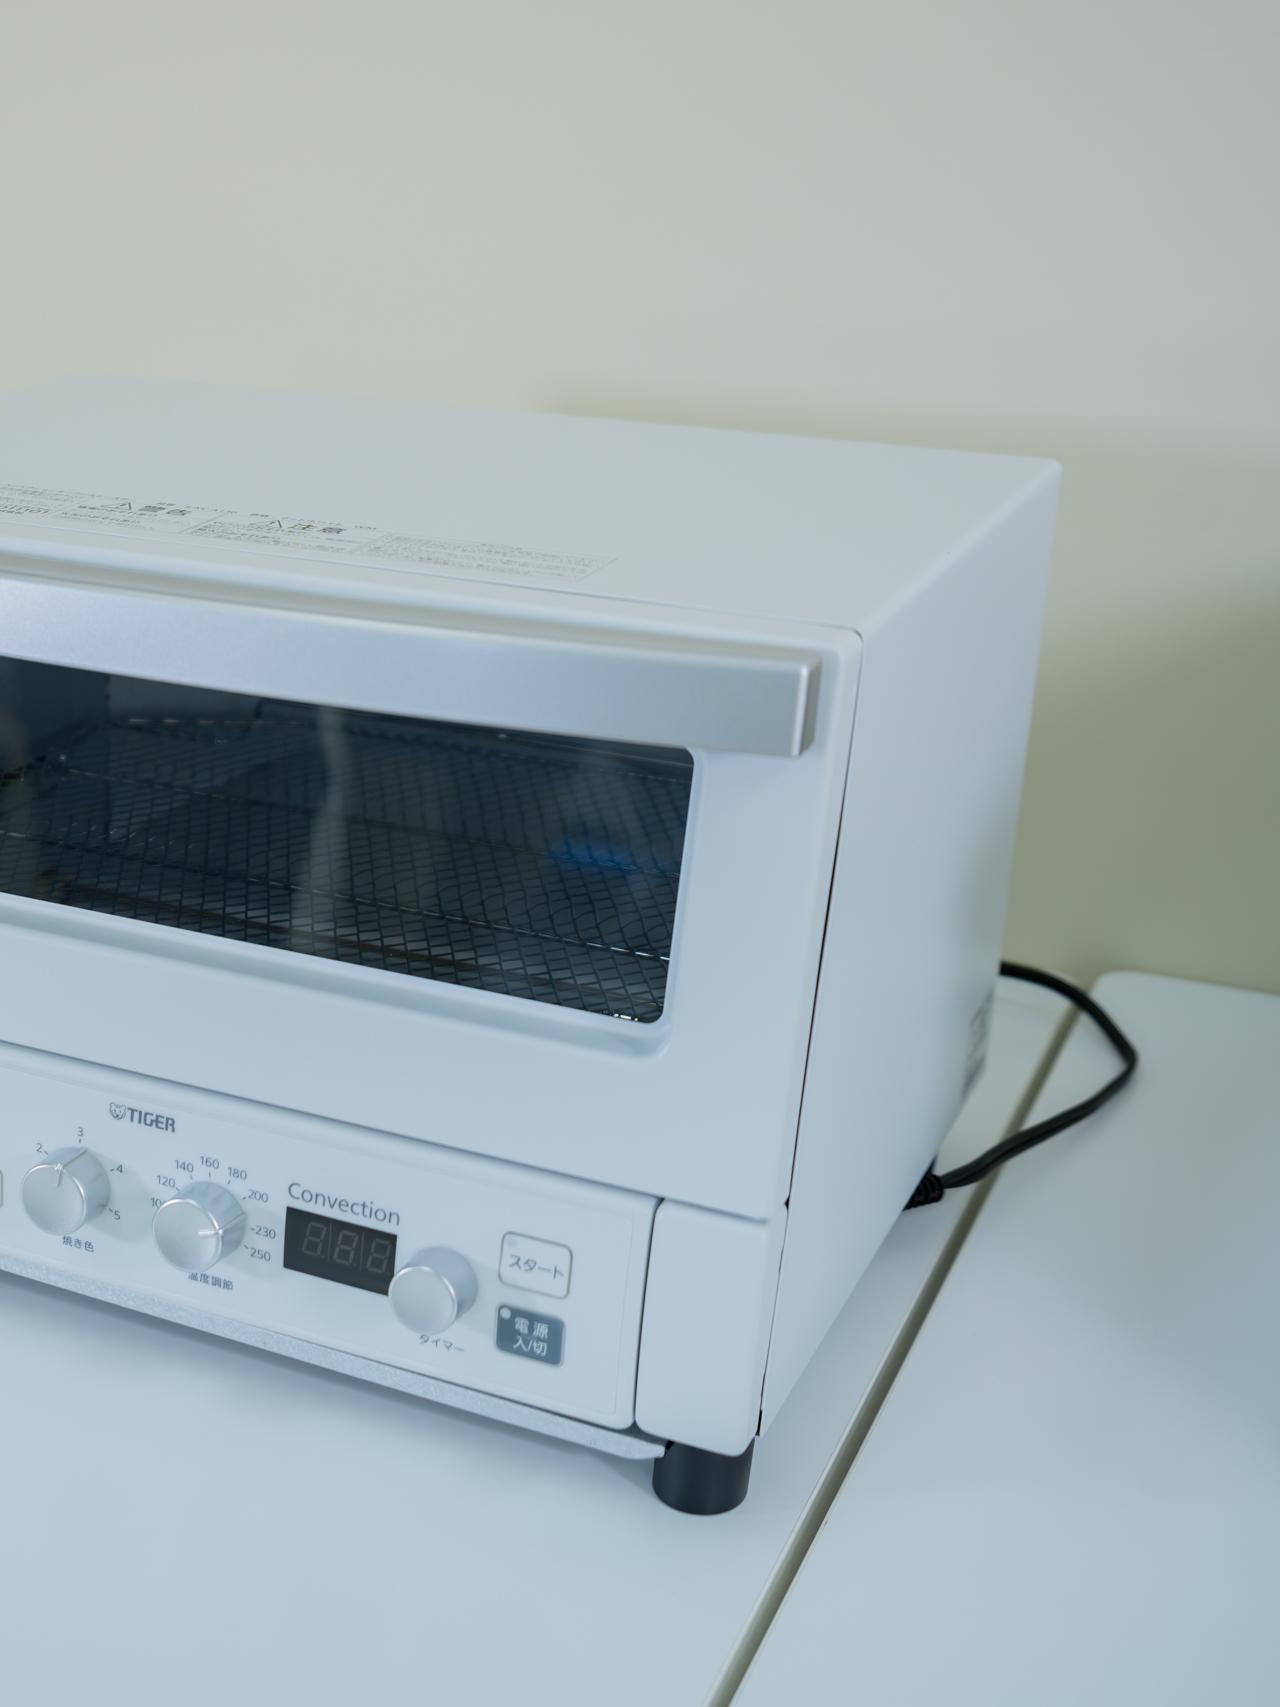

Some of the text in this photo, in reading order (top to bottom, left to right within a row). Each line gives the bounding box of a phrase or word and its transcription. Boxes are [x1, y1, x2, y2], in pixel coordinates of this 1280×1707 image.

[127, 1107, 176, 1133] TIGER
[77, 1126, 84, 1137] 3
[174, 1159, 194, 1173] 140
[200, 1156, 220, 1169] 160
[156, 1175, 176, 1189] 120
[227, 1167, 248, 1181] 180
[248, 1189, 269, 1203] 200
[287, 1182, 401, 1226] Convection
[255, 1225, 276, 1240] 230
[62, 1235, 95, 1253] 焼き色
[250, 1247, 271, 1262] 250
[509, 1253, 564, 1279] スタート
[188, 1272, 233, 1290] 温度調節
[514, 1317, 549, 1338] 電源
[418, 1334, 466, 1352] タイマー
[513, 1335, 548, 1357] 入/切
